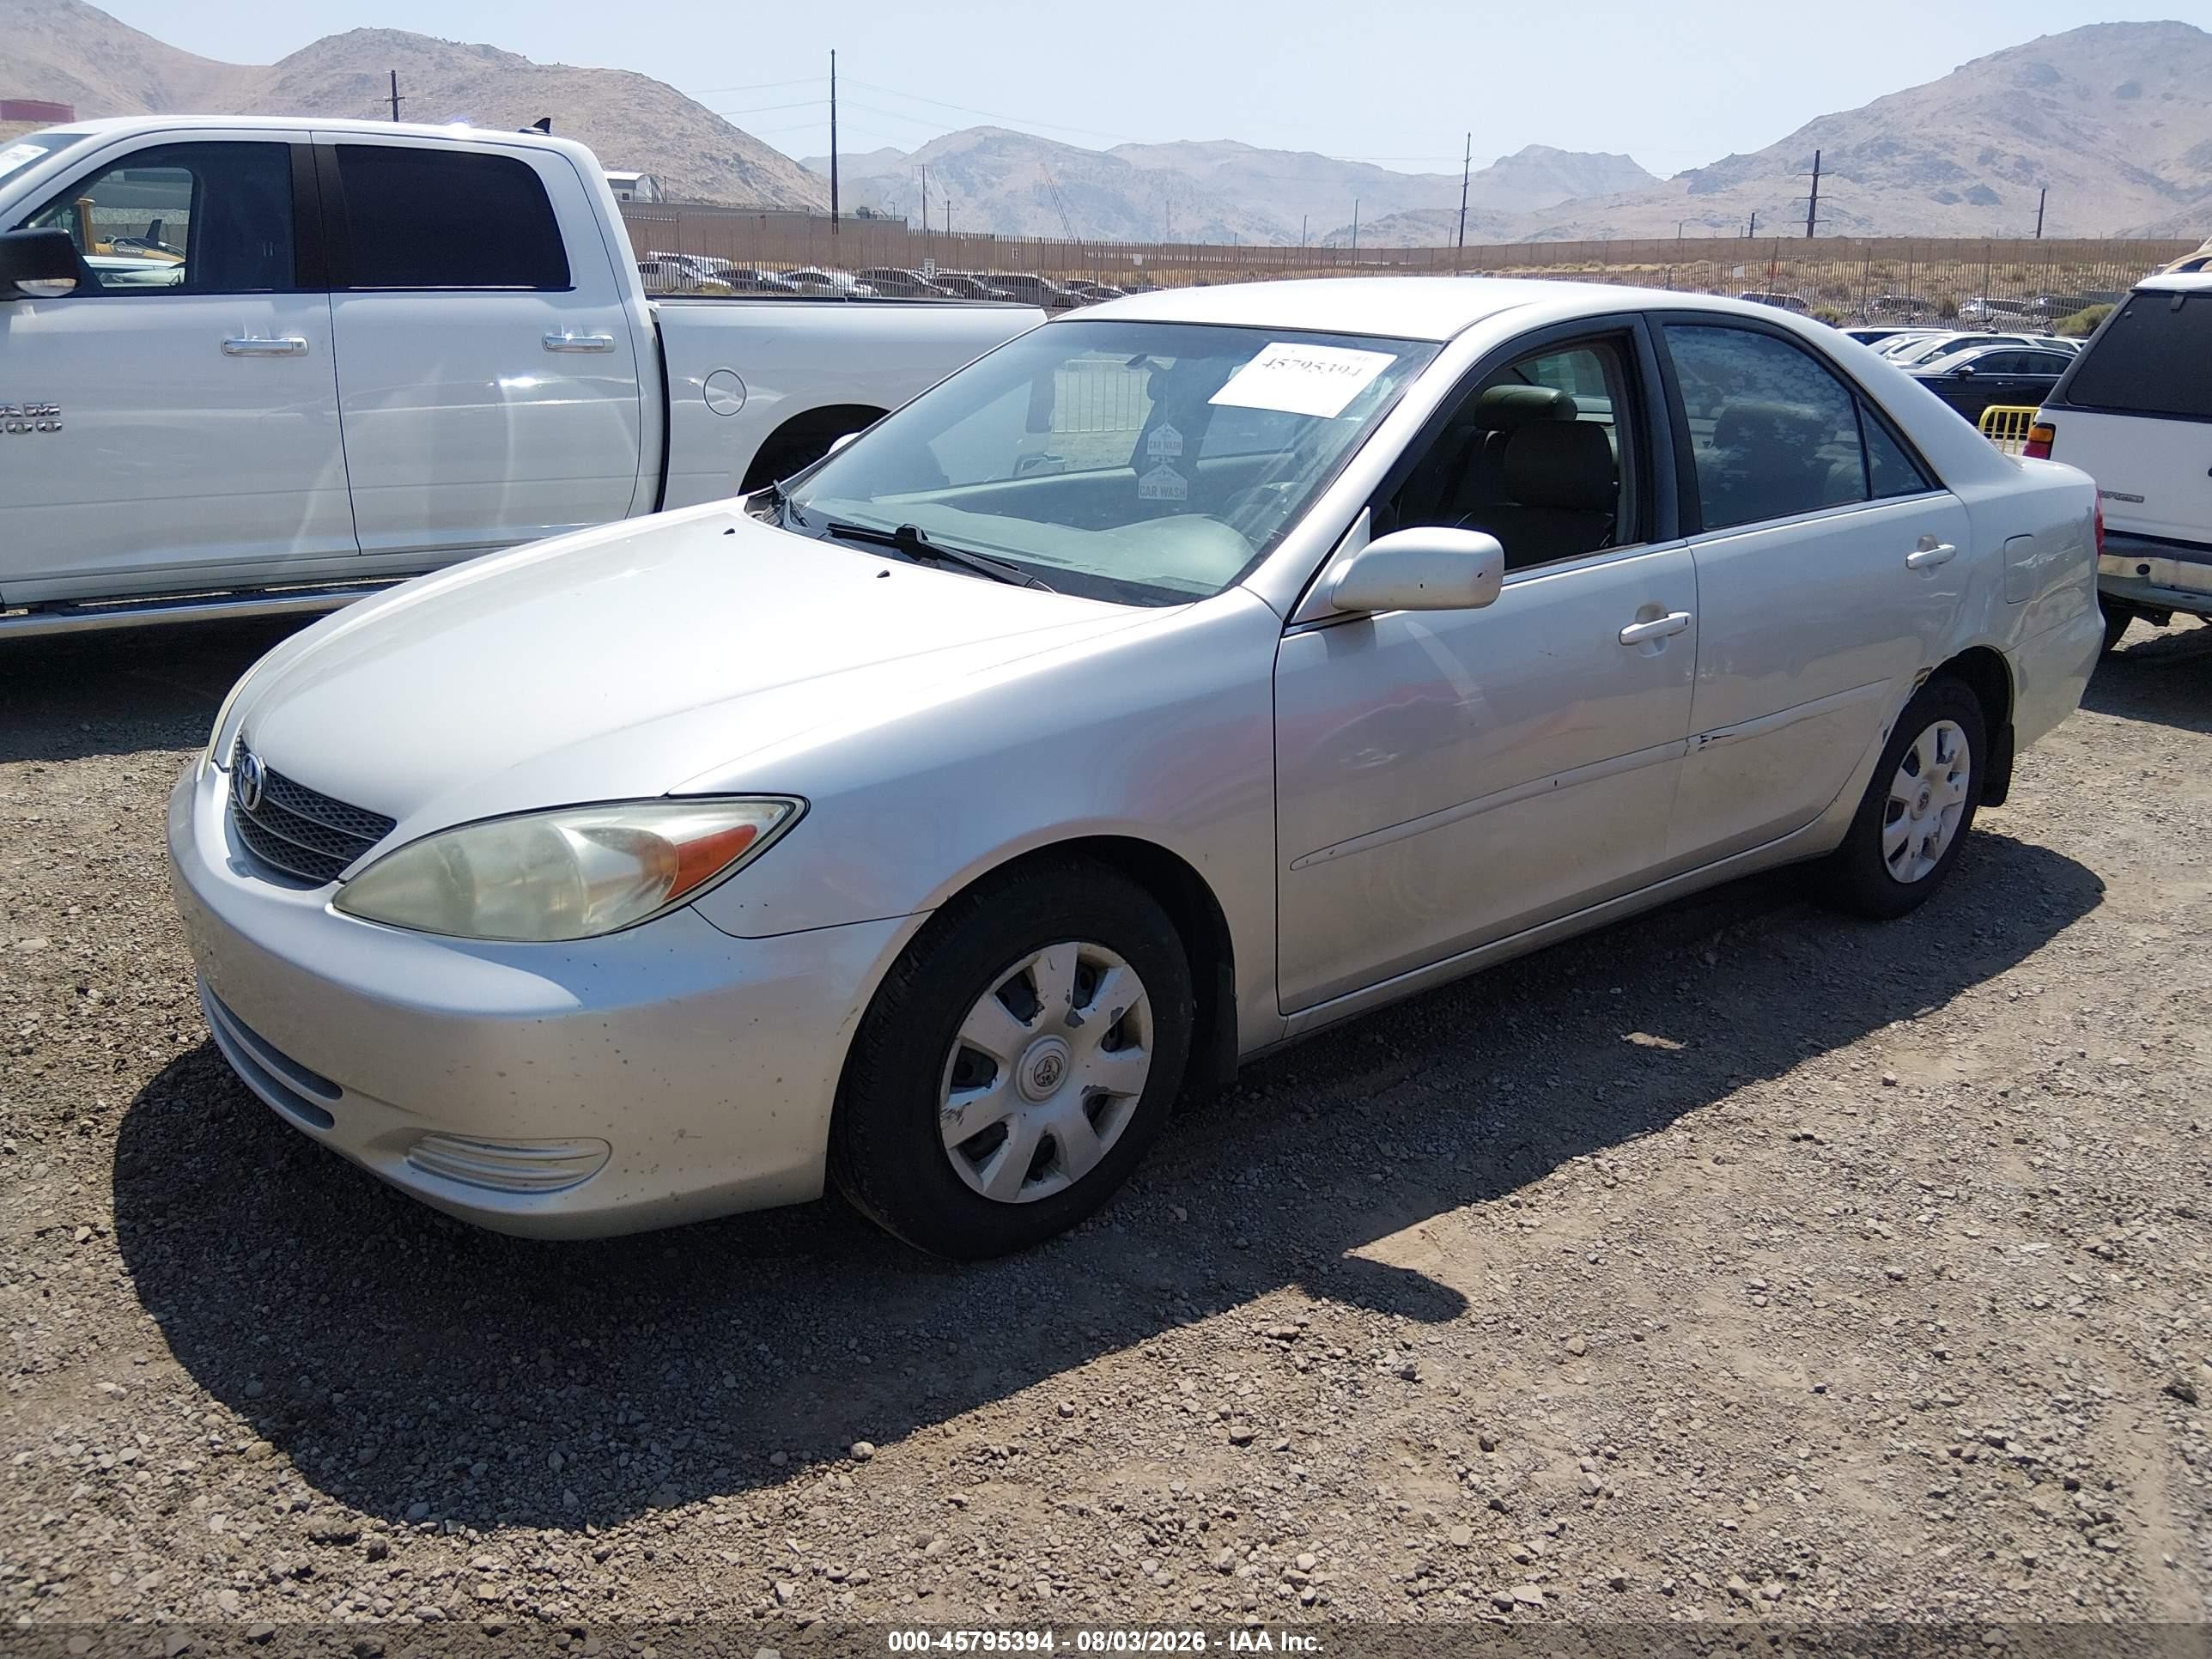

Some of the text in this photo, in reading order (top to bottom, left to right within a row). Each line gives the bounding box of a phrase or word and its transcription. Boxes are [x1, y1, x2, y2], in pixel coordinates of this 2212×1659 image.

[1261, 357, 1363, 377] 45795394
[0, 418, 63, 435] 00
[1139, 485, 1186, 498] CAR WASH
